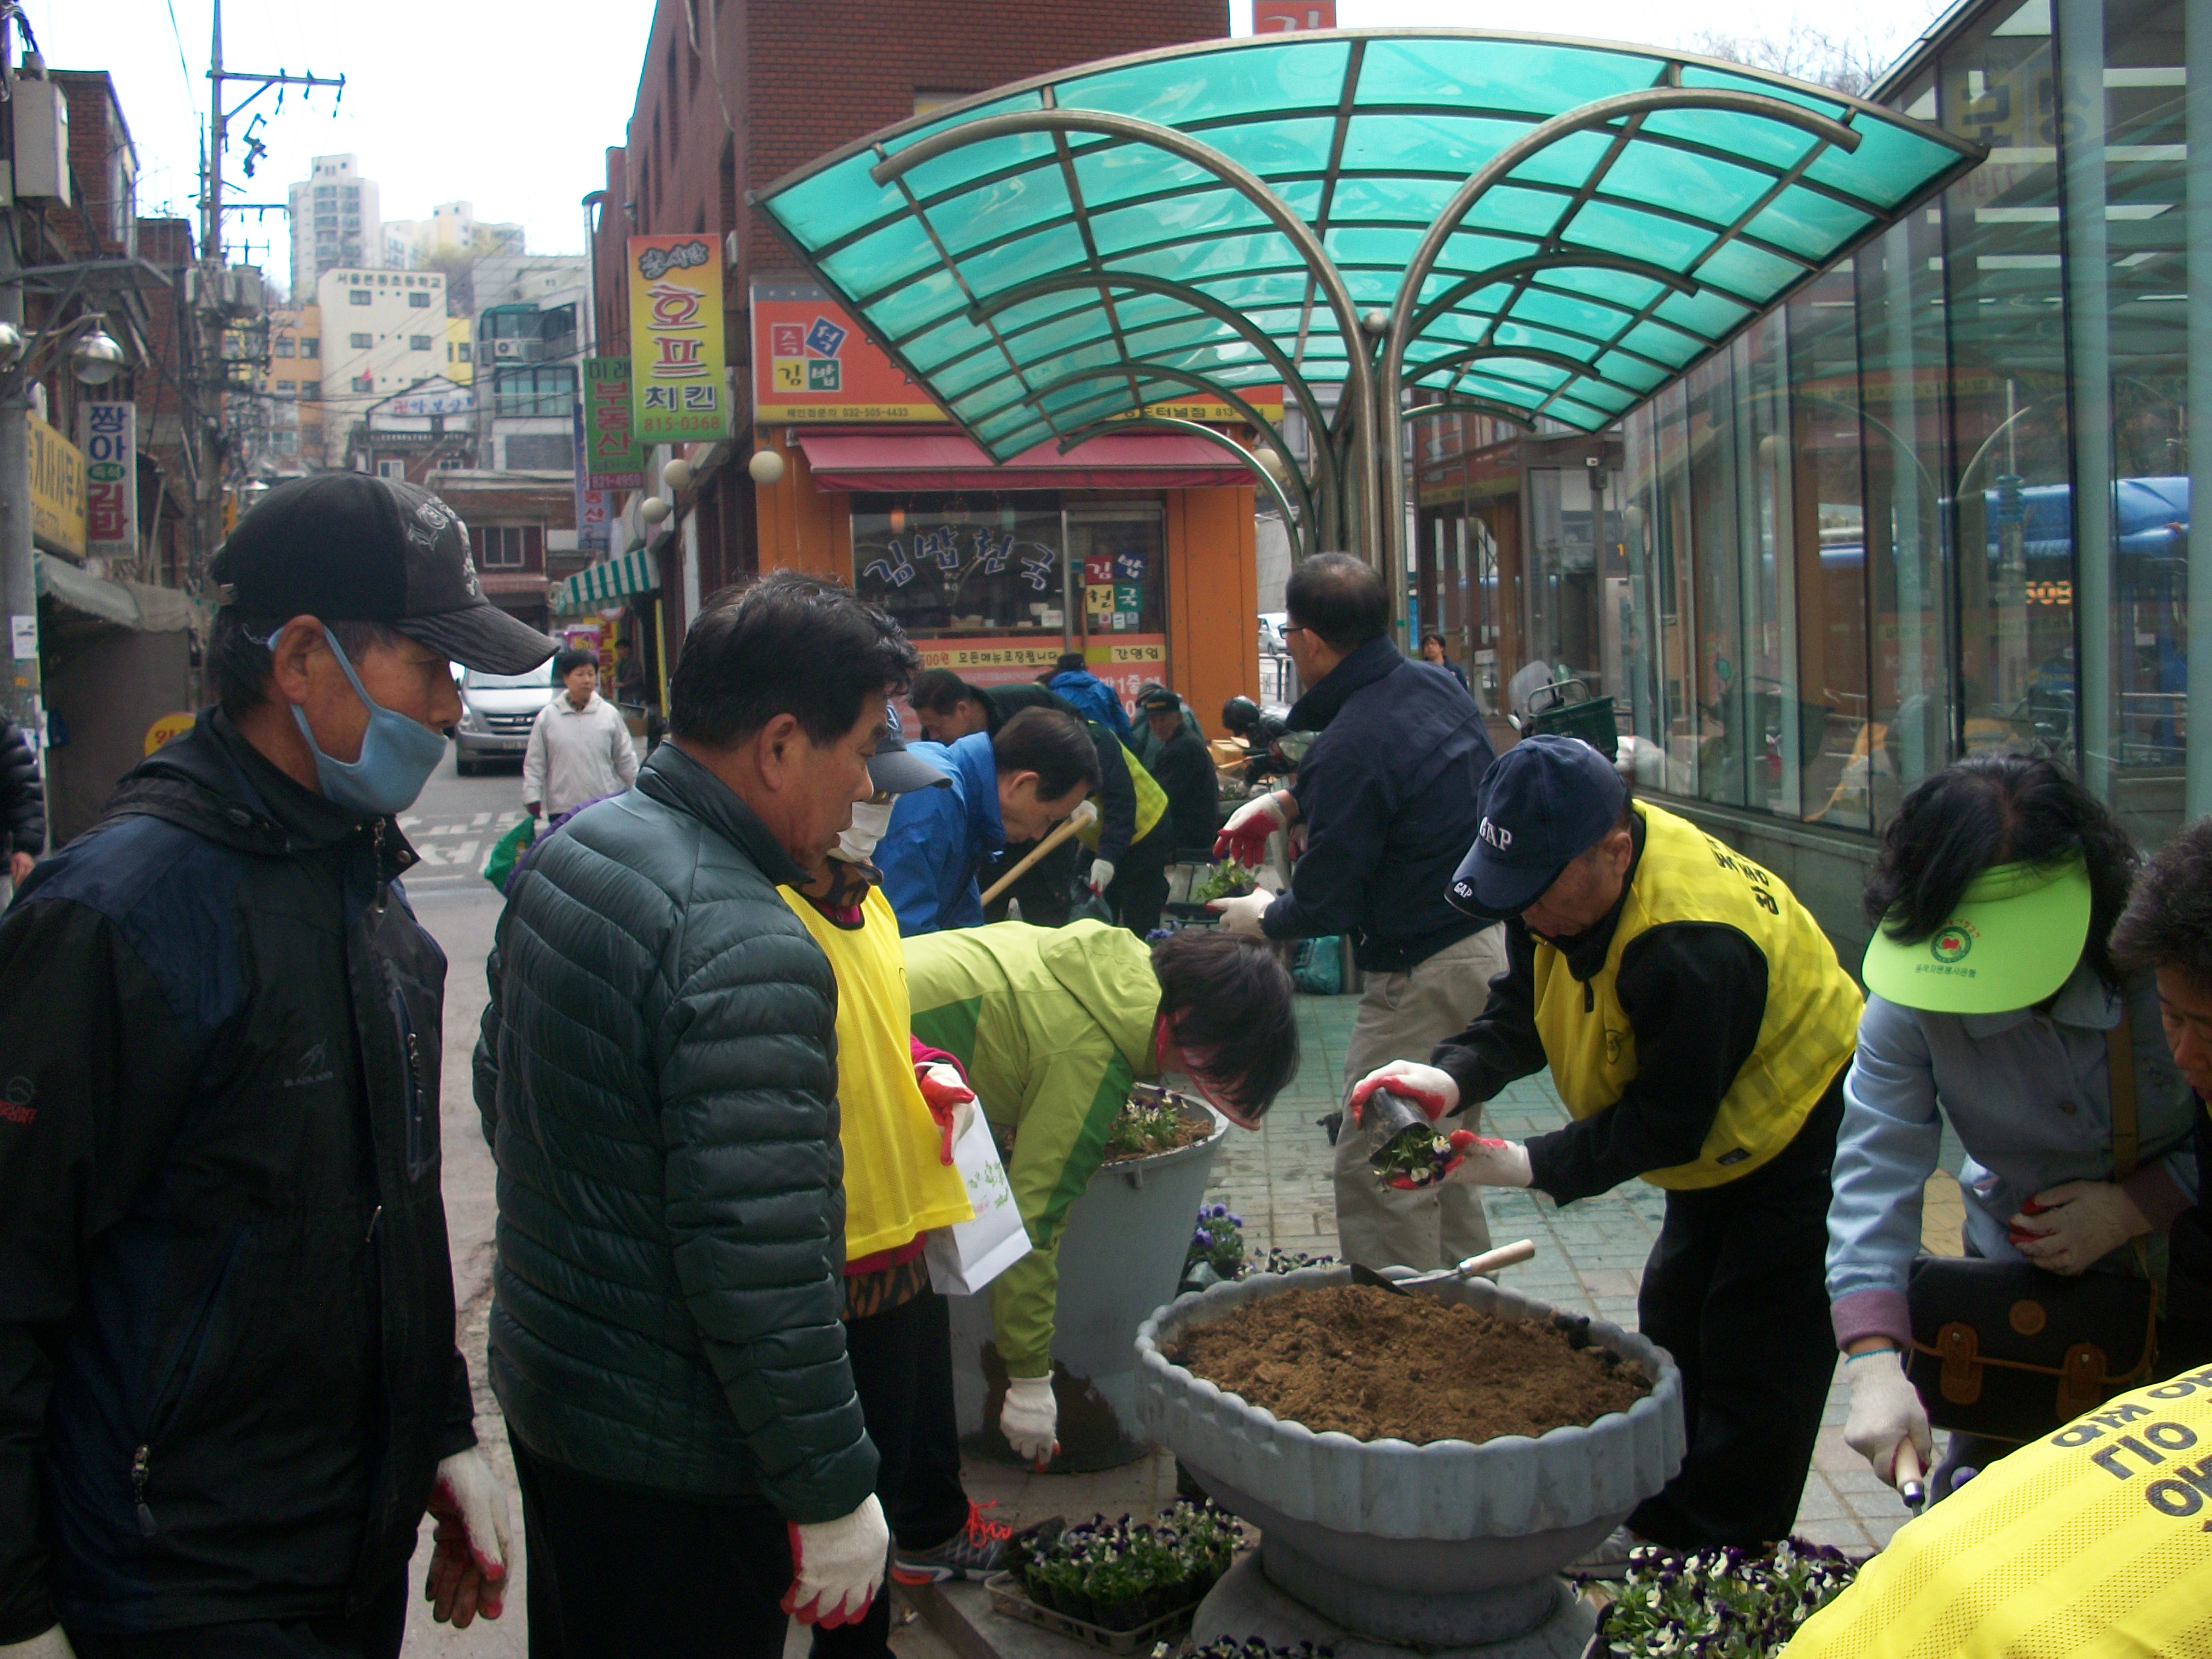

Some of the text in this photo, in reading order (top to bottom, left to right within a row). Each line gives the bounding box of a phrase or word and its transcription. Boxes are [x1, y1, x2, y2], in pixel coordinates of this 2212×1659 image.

[647, 283, 711, 379] 호프
[777, 363, 836, 387] 김밥
[643, 385, 717, 412] 치킨
[593, 381, 631, 457] 부동산
[643, 416, 721, 432] 815-0368
[842, 408, 909, 417] 032-505-4433
[863, 525, 1055, 590] 김밥천국
[1086, 554, 1143, 580] 김밥
[1087, 587, 1137, 609] 천국
[1479, 816, 1513, 852] GAP
[1454, 881, 1473, 898] GAP
